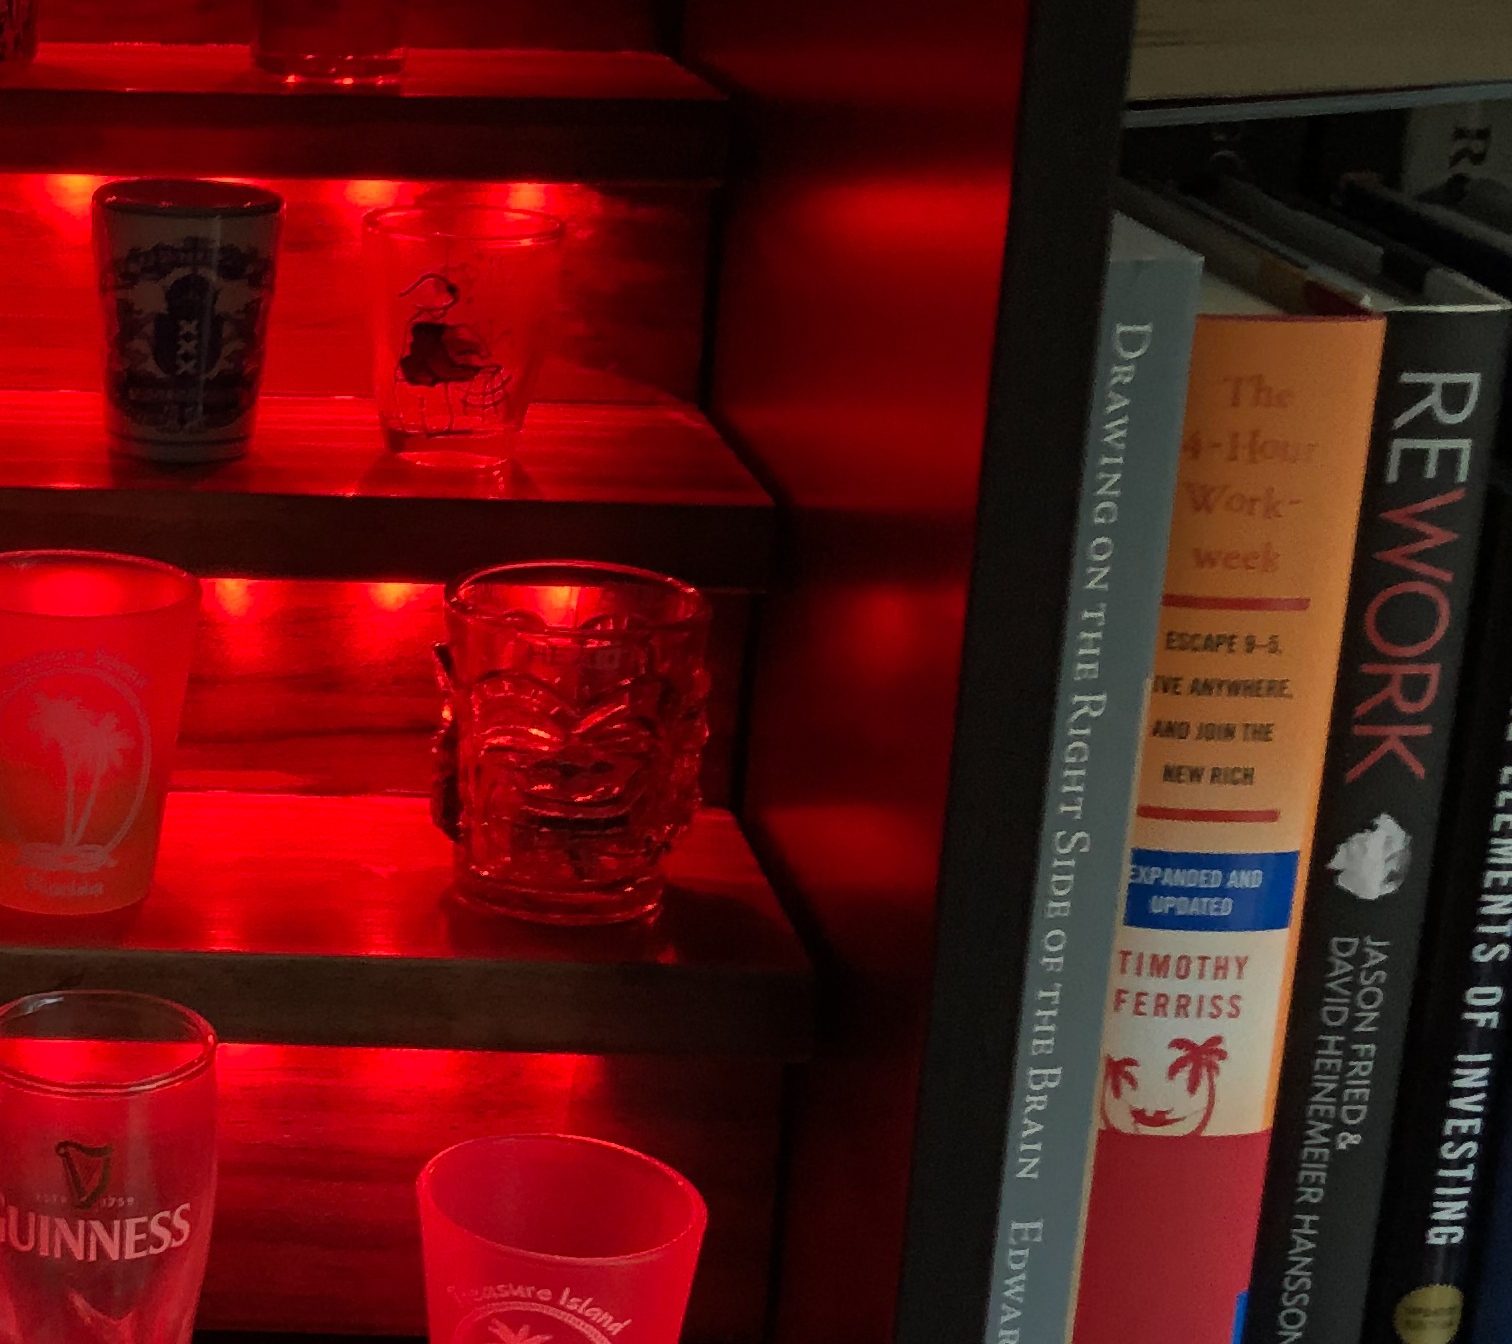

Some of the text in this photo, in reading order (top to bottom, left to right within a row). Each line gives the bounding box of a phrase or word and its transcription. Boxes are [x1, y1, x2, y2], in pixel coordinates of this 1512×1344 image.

[1223, 373, 1292, 407] The
[1193, 541, 1281, 573] week
[1345, 371, 1482, 783] REWORK
[1166, 630, 1237, 654] ESCAPE
[1153, 674, 1184, 696] IVE
[1152, 720, 1275, 743] AND JOIN THE
[1162, 763, 1255, 786] NEW RICH
[1226, 868, 1264, 889] AND
[1149, 894, 1233, 917] UPDATED
[1118, 949, 1249, 980] TIMOTHY
[1319, 936, 1360, 1028] DAVID
[1113, 988, 1242, 1020] FERRISS
[1459, 985, 1505, 1031] OF
[1335, 935, 1390, 1151] JASON FRIED &
[1294, 1034, 1346, 1205] HEINEMEIER
[1424, 1052, 1494, 1247] INVESTING
[560, 1287, 633, 1337] Island
